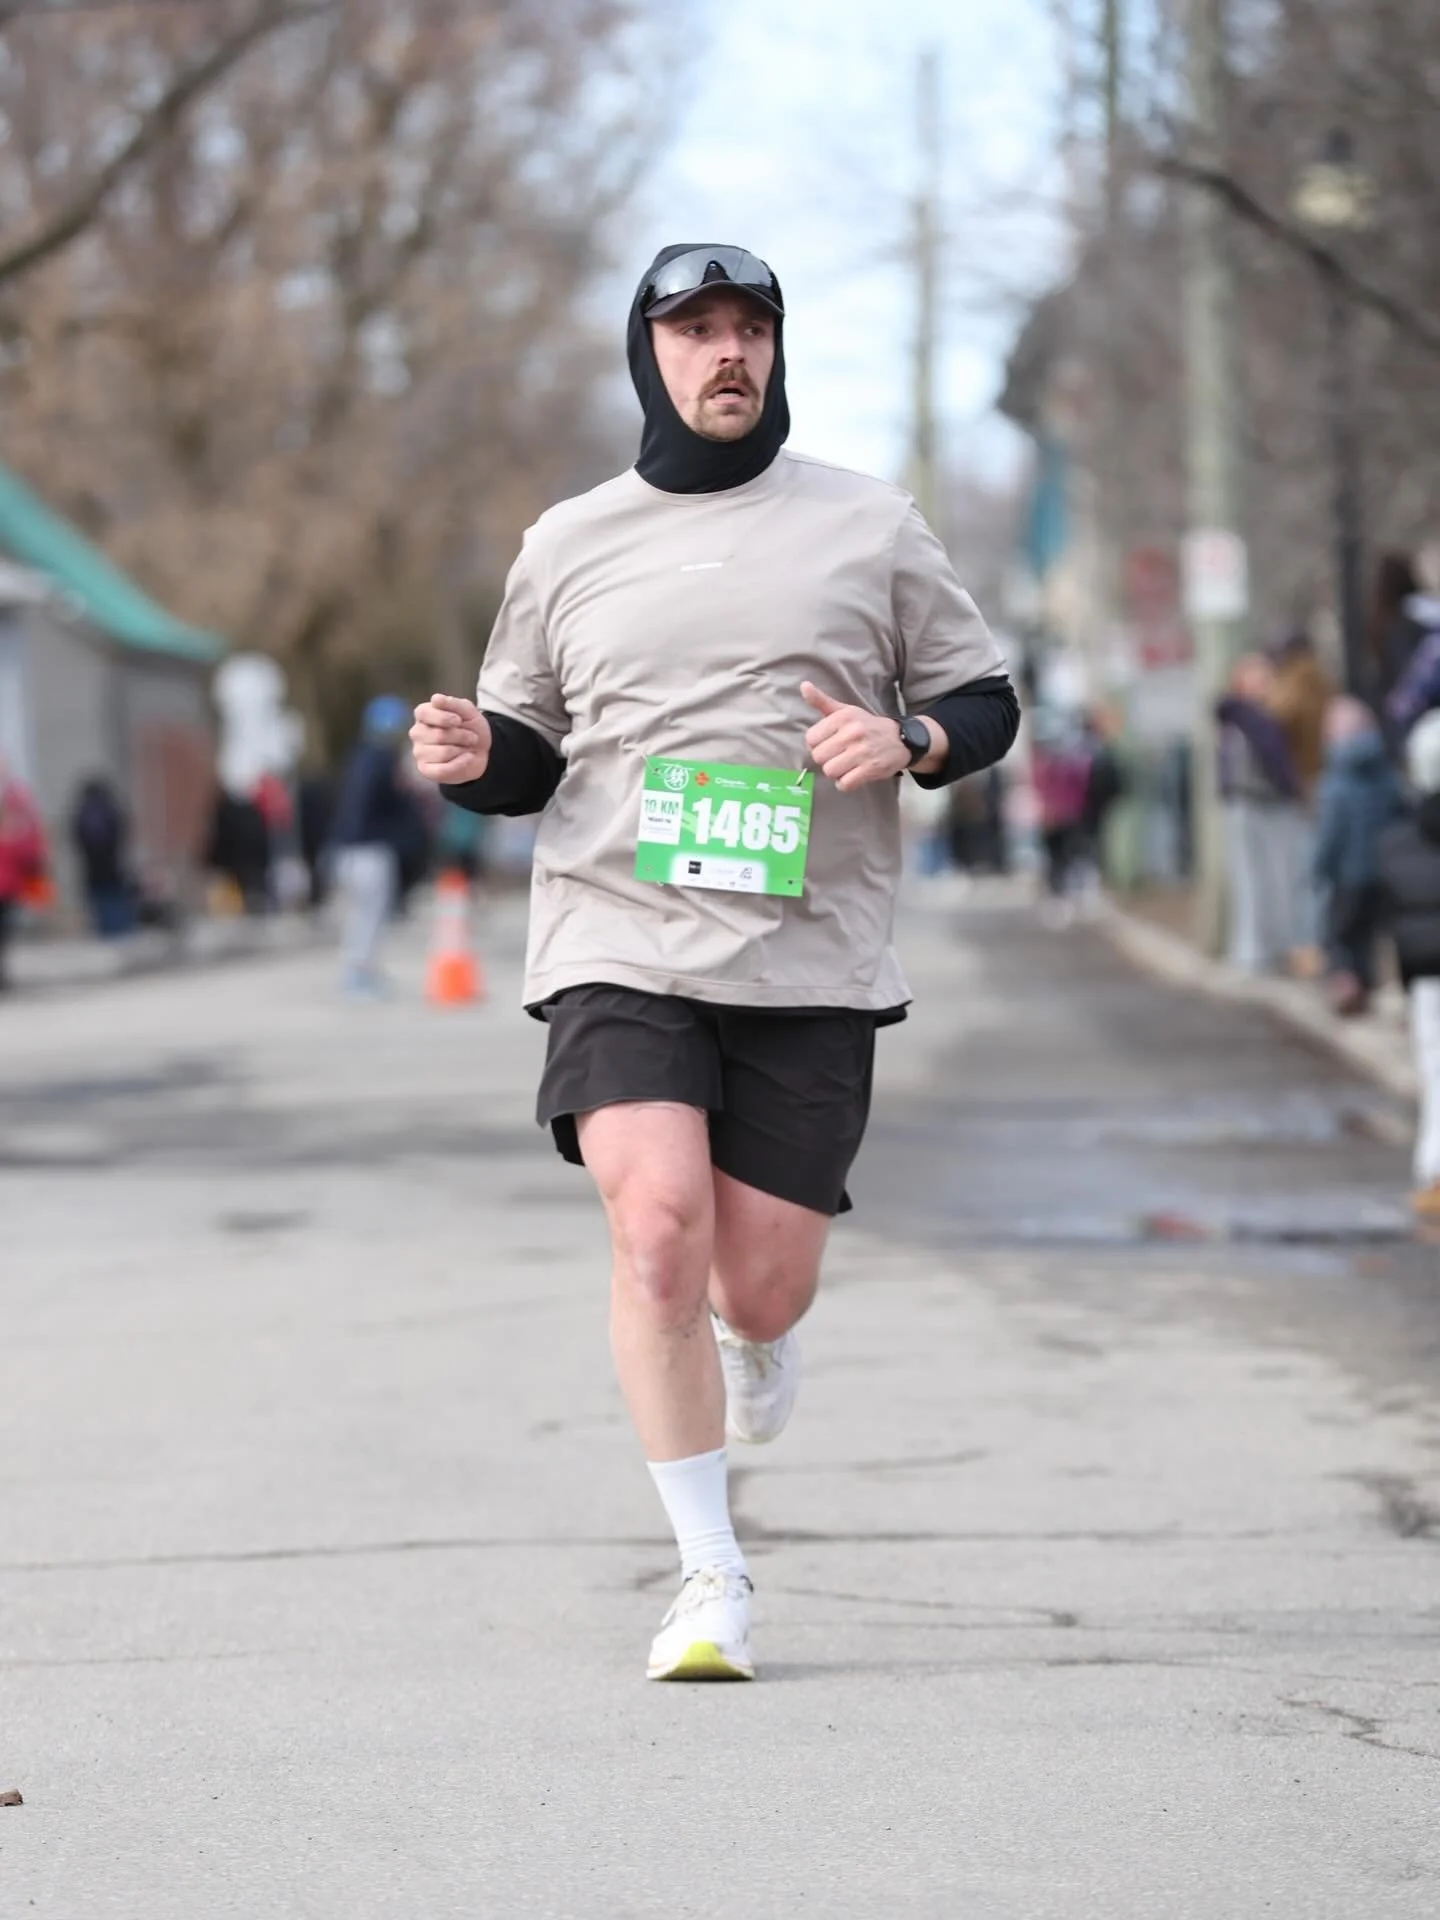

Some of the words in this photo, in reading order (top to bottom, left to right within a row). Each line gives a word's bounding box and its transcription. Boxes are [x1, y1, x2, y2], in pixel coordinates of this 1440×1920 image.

[644, 799, 657, 813] 10
[661, 800, 679, 816] KM
[692, 797, 801, 854] 1485
